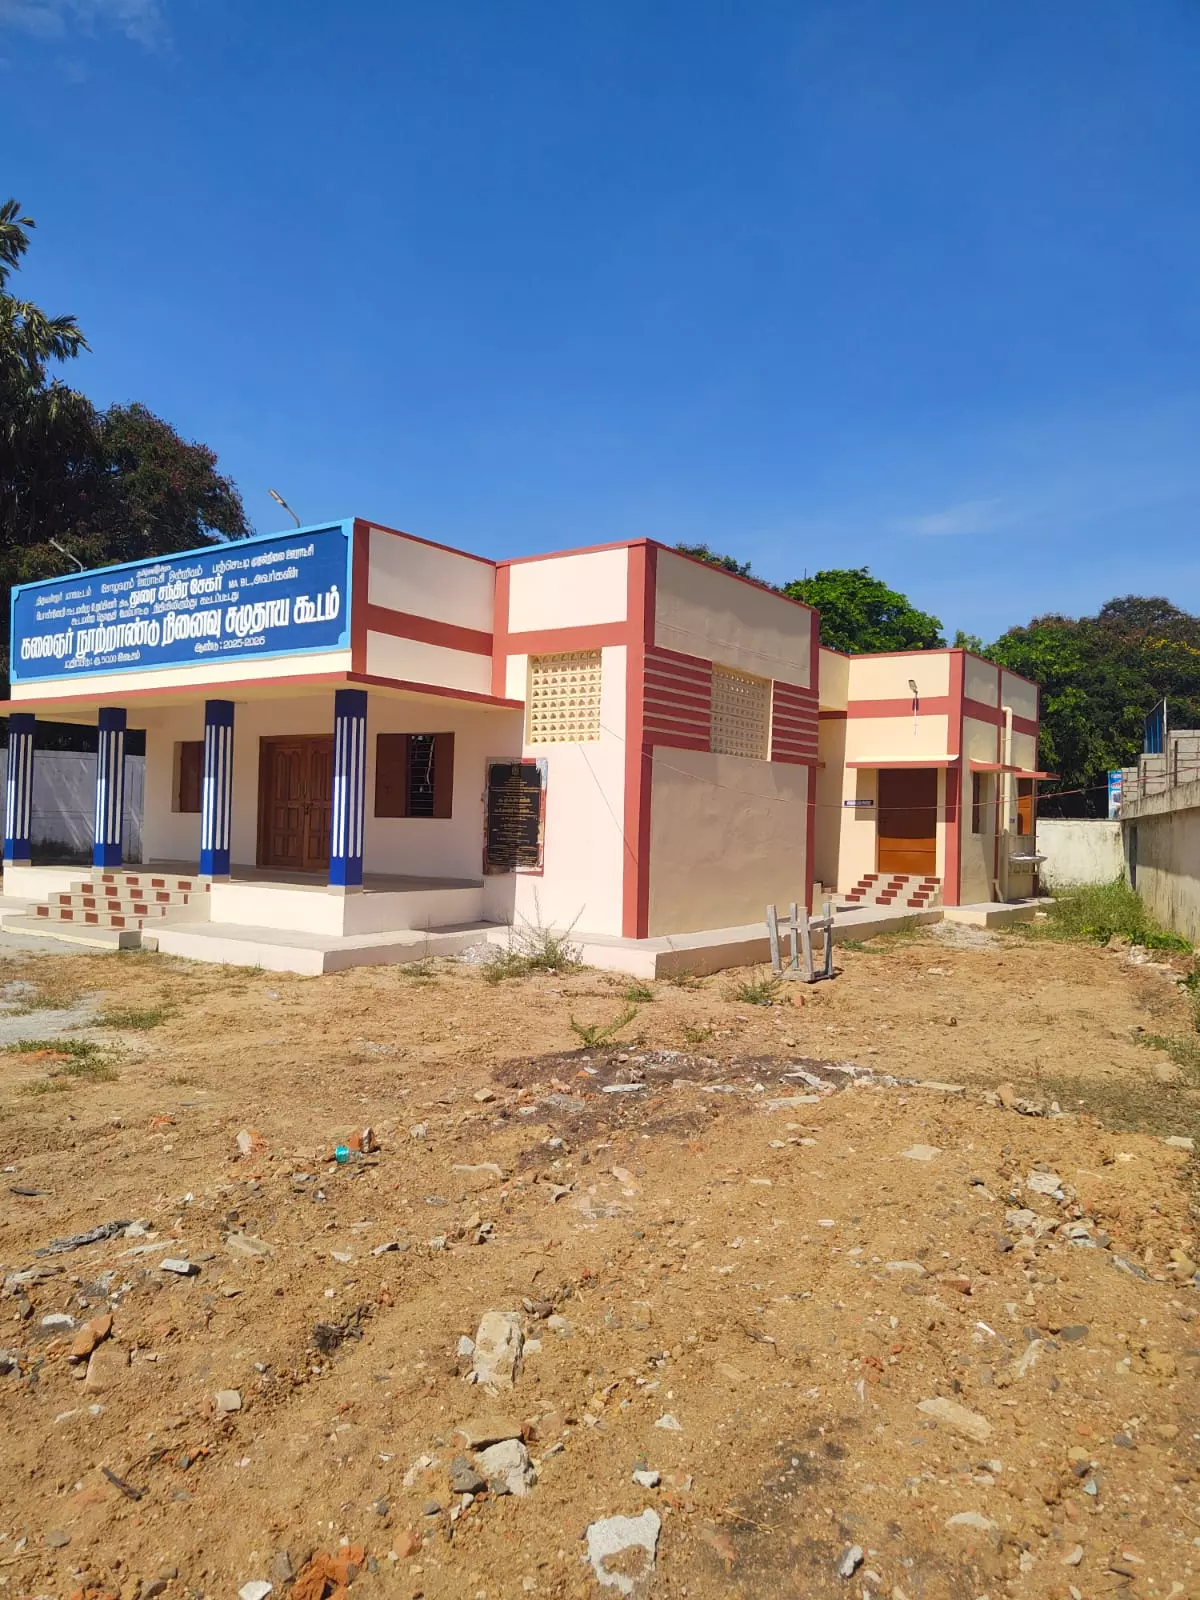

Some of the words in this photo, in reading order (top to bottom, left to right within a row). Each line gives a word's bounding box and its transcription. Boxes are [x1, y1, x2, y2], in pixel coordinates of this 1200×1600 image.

[168, 565, 203, 582] ஒன்றியம்
[129, 588, 156, 608] துரை
[190, 572, 223, 595] சேகர்
[21, 627, 74, 660] கலைஞர்
[75, 616, 160, 659] நூற்றாண்டு
[161, 608, 222, 647] நினைவு
[225, 598, 290, 637] சமுதாய
[293, 585, 340, 624] கூடம்
[223, 636, 266, 650] 2025-2026
